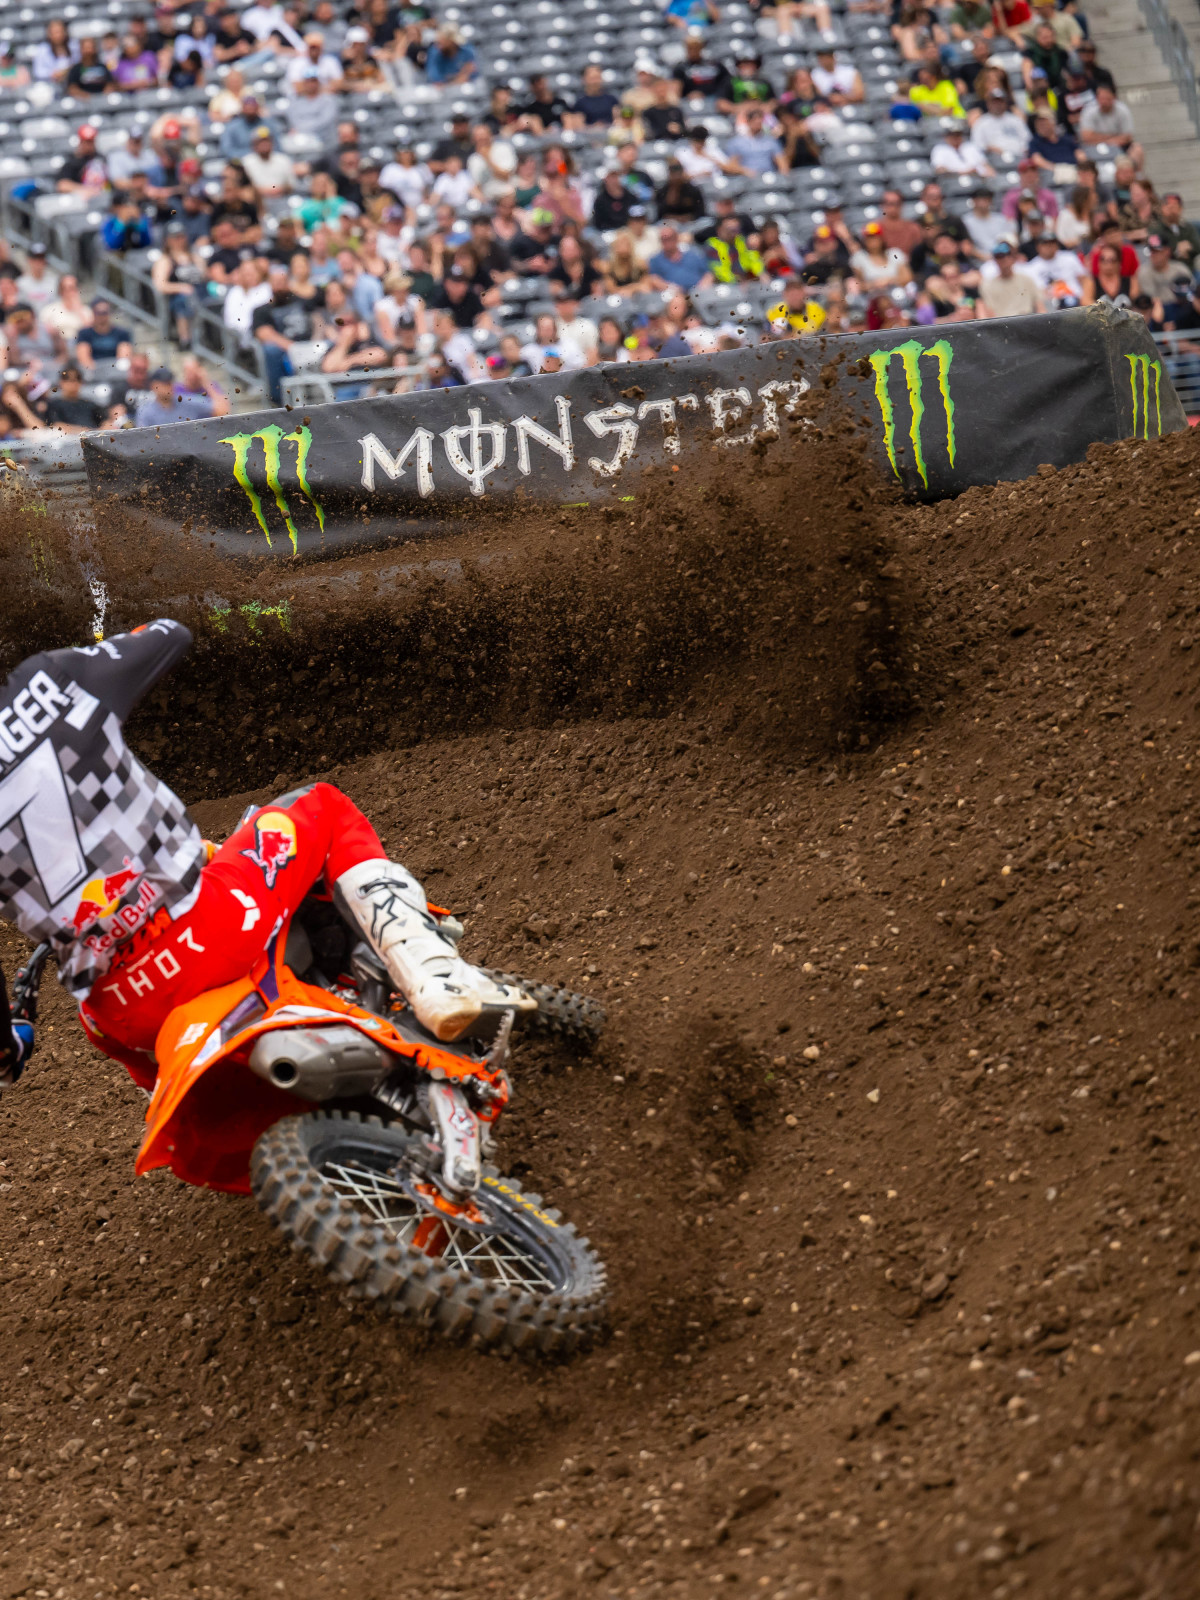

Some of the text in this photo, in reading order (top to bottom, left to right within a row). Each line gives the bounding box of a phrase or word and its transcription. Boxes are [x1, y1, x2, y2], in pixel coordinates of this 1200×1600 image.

[357, 377, 814, 497] MONSTER
[85, 879, 157, 958] Red Bull
[483, 1176, 559, 1228] DUNLOP
